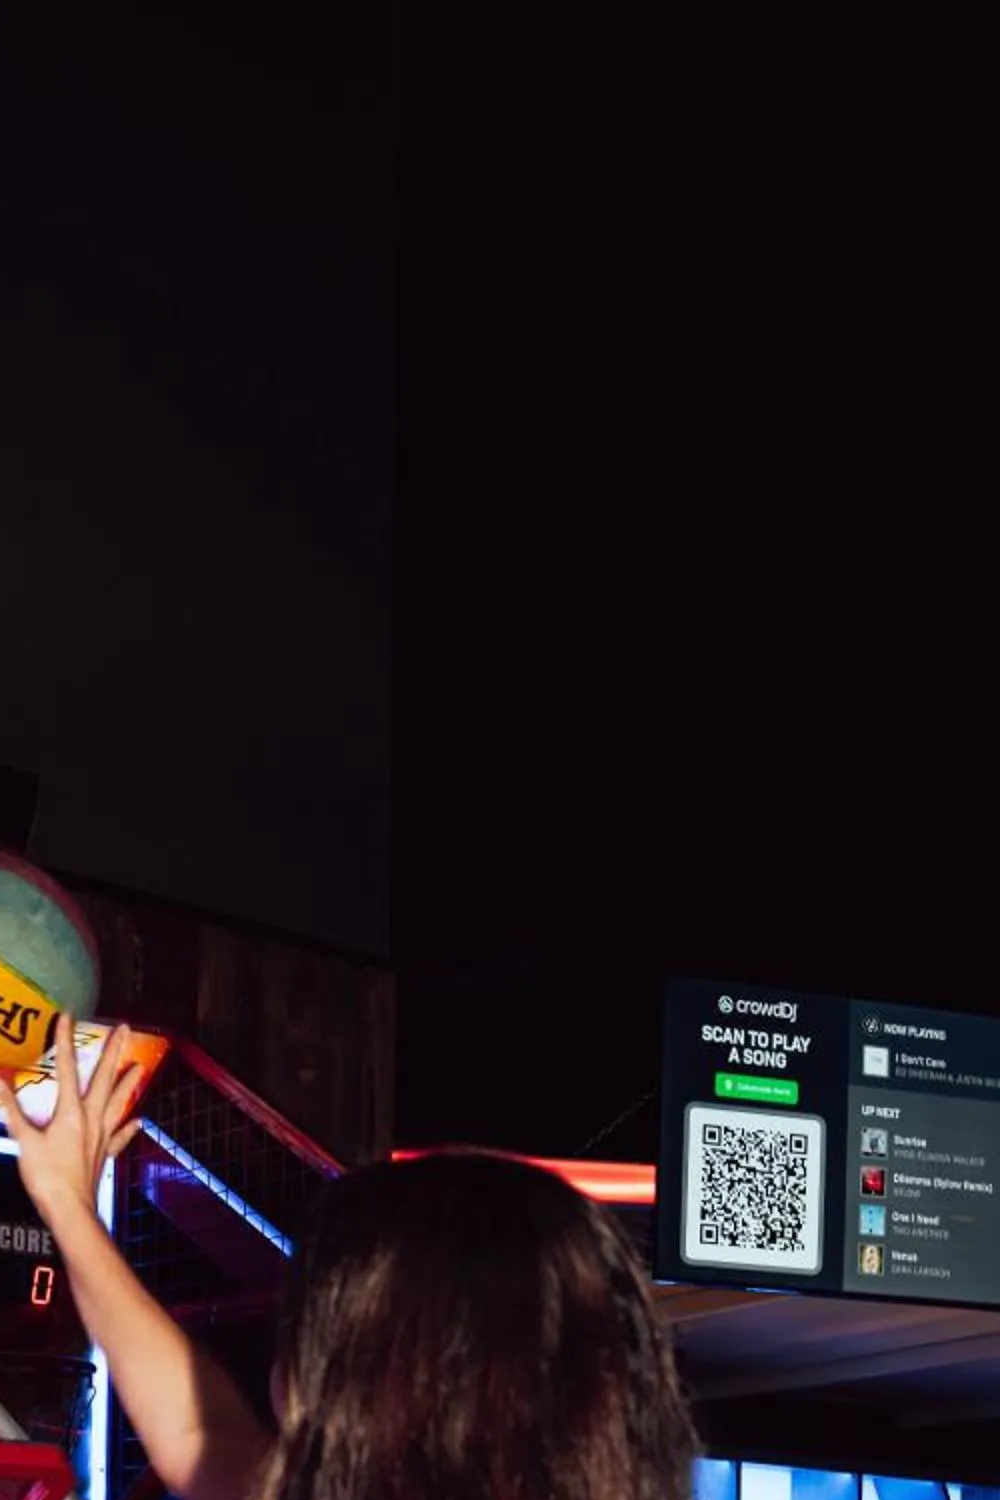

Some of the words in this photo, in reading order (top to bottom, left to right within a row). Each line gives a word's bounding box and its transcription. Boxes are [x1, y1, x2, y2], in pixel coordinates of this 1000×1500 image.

[701, 1025, 745, 1046] SCAN
[747, 1030, 769, 1048] TO
[772, 1033, 811, 1053] PLAY
[727, 1046, 741, 1064] A
[743, 1048, 788, 1069] SONG
[861, 1105, 875, 1116] UP
[30, 1265, 55, 1305] 0
